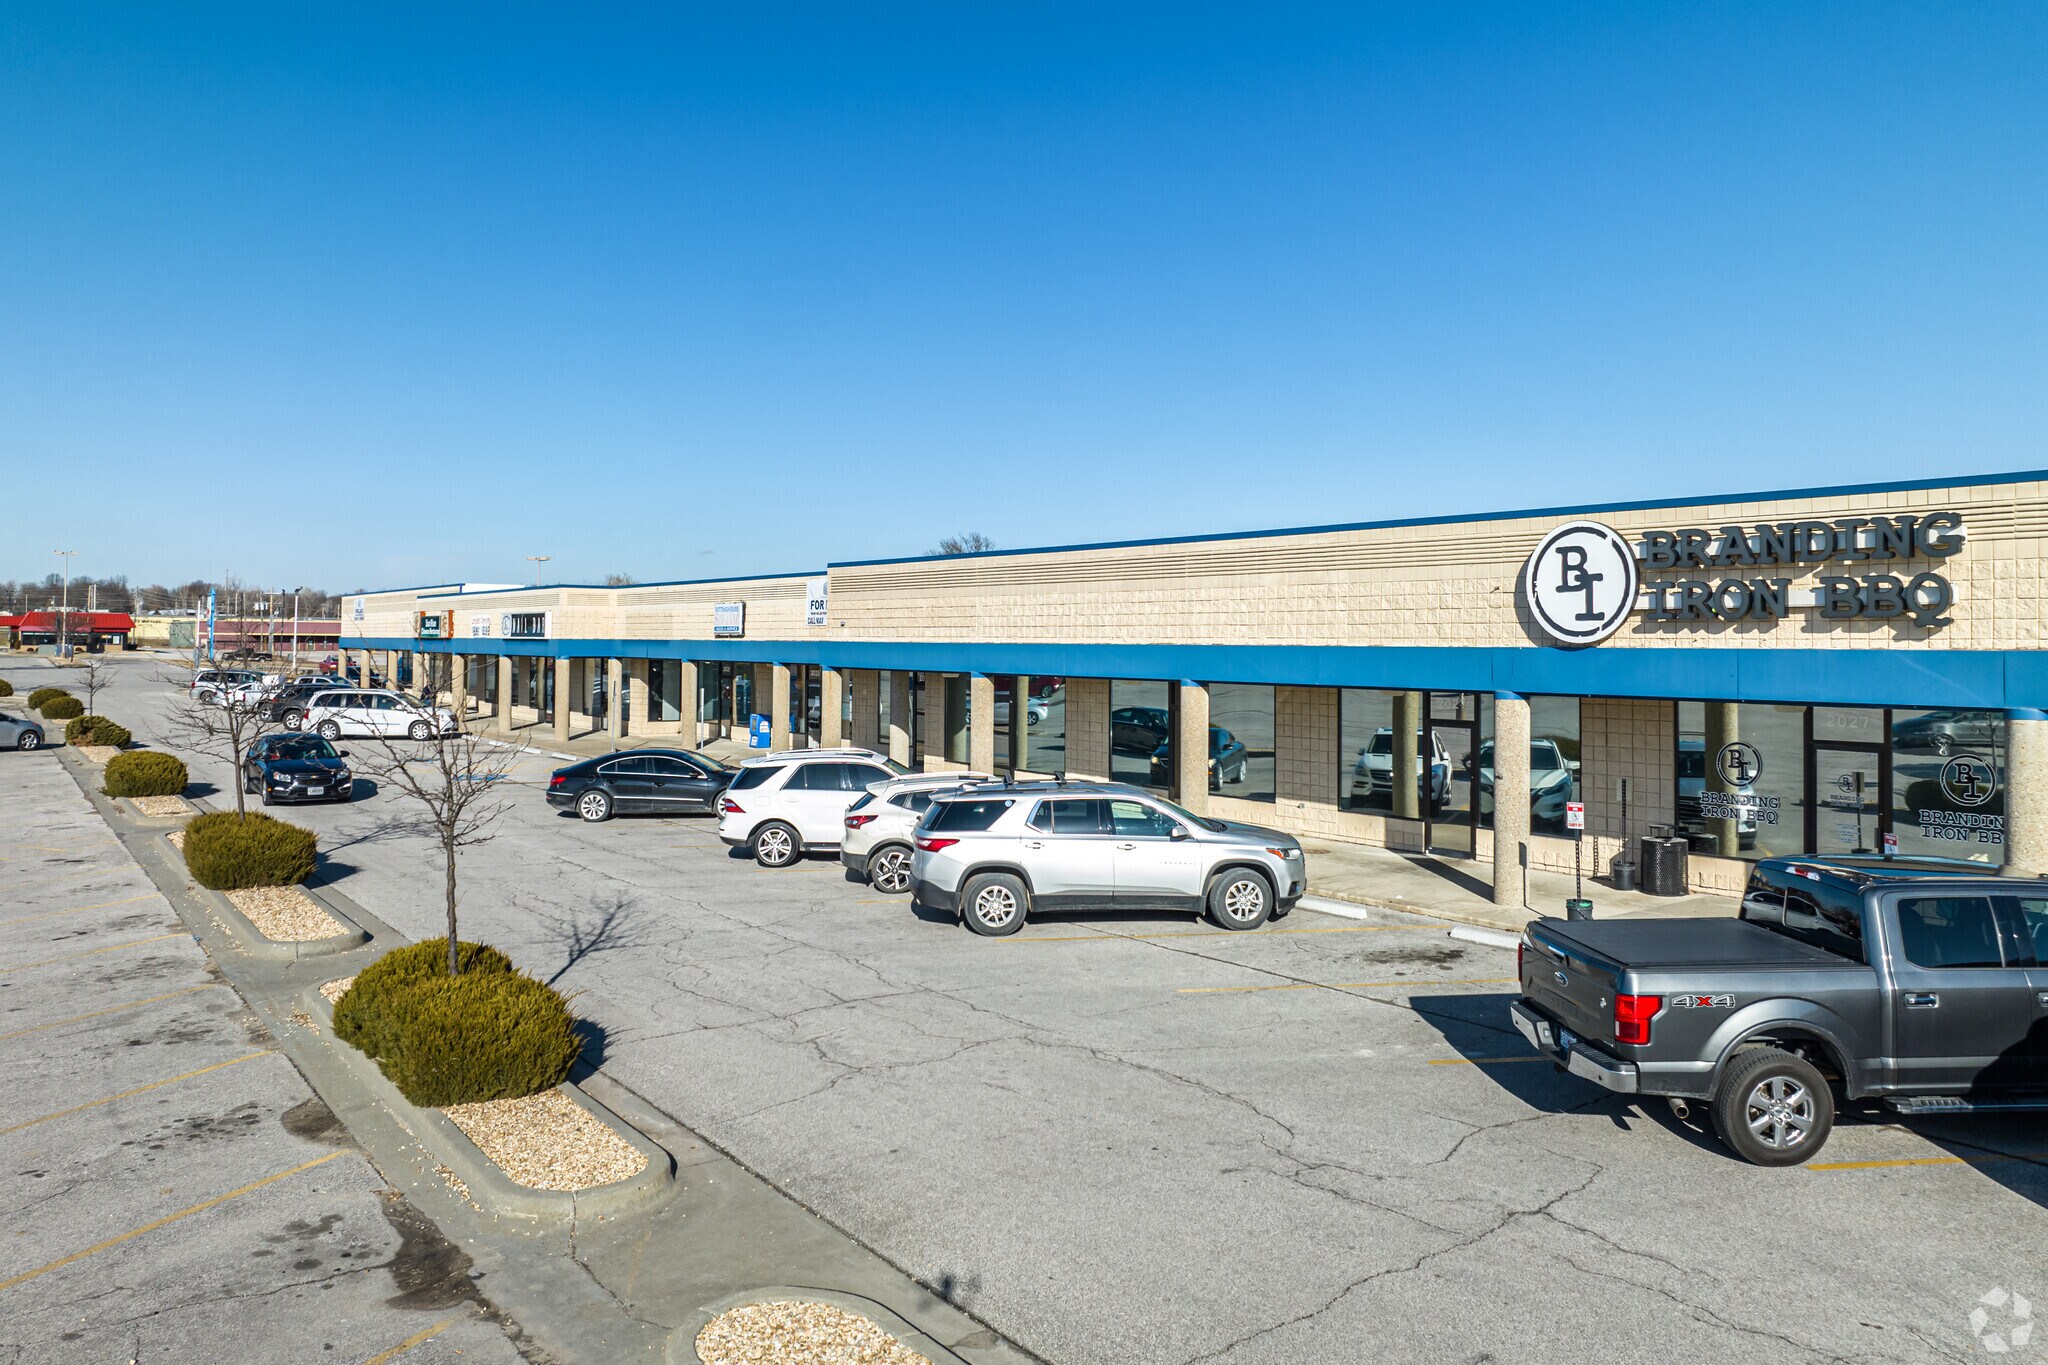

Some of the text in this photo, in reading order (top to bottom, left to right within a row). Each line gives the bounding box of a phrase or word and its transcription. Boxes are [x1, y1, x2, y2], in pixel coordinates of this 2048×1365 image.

[1641, 512, 1963, 569] BRANDING
[810, 600, 824, 610] FOR
[1646, 572, 1954, 628] IRON BBQ
[1825, 715, 1870, 729] 2027
[1700, 791, 1780, 809] BRANDING
[1701, 806, 1779, 825] IRON BBQ
[1919, 808, 2004, 830] BRANDIN
[1921, 825, 2004, 846] IRON BB
